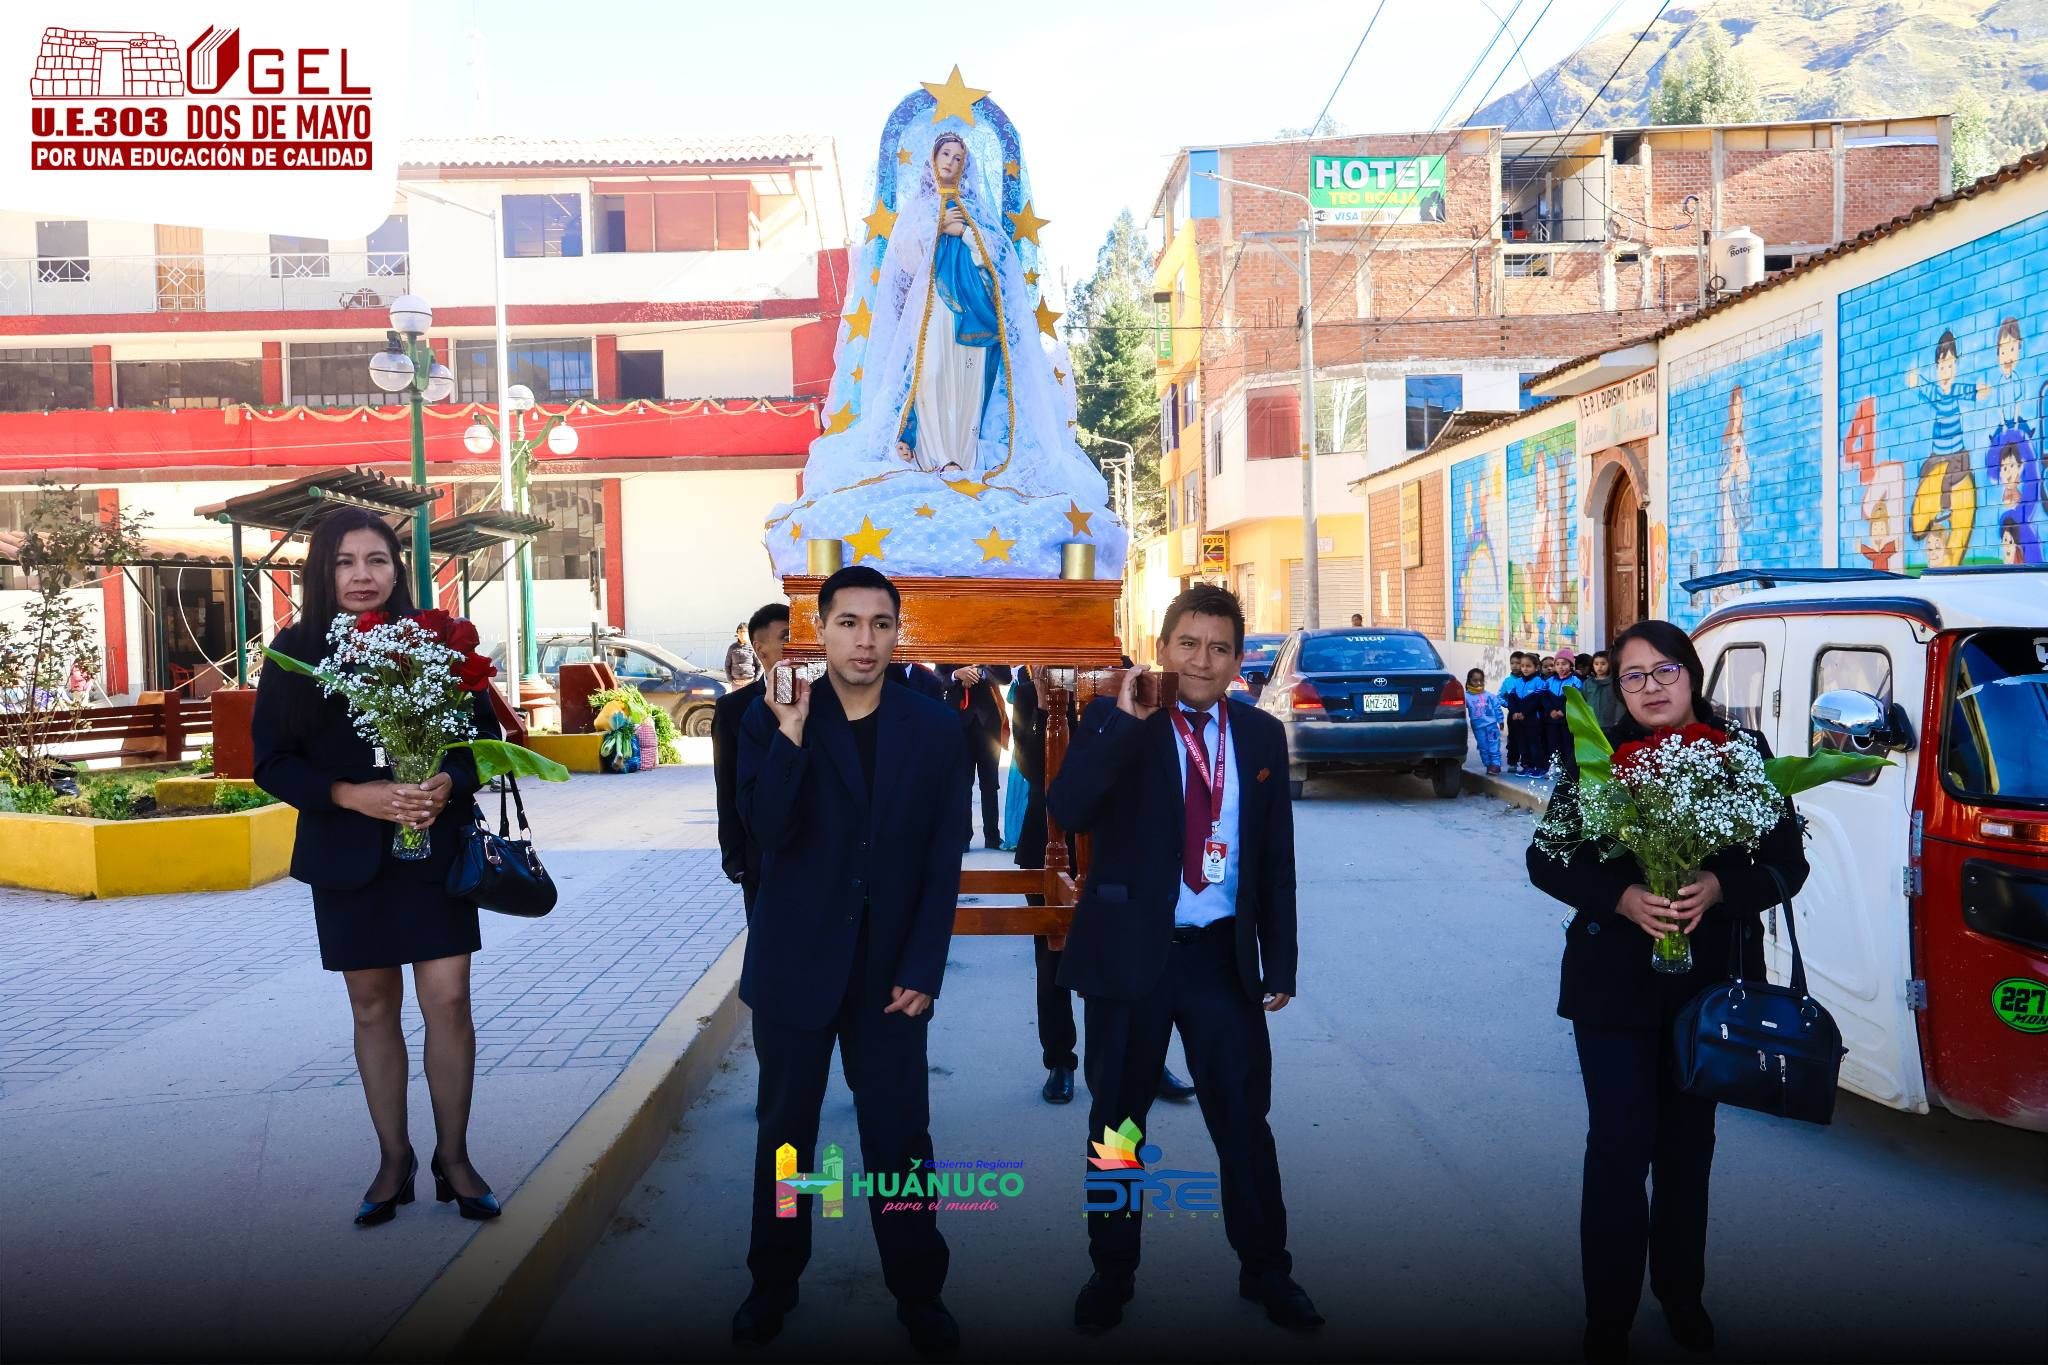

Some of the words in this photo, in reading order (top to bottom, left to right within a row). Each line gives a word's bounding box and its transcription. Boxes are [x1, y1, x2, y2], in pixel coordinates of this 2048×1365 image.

[1315, 159, 1440, 189] HOTEL
[1335, 212, 1359, 220] VISA
[1365, 698, 1397, 709] AMZ-204
[2000, 986, 2046, 1014] 227
